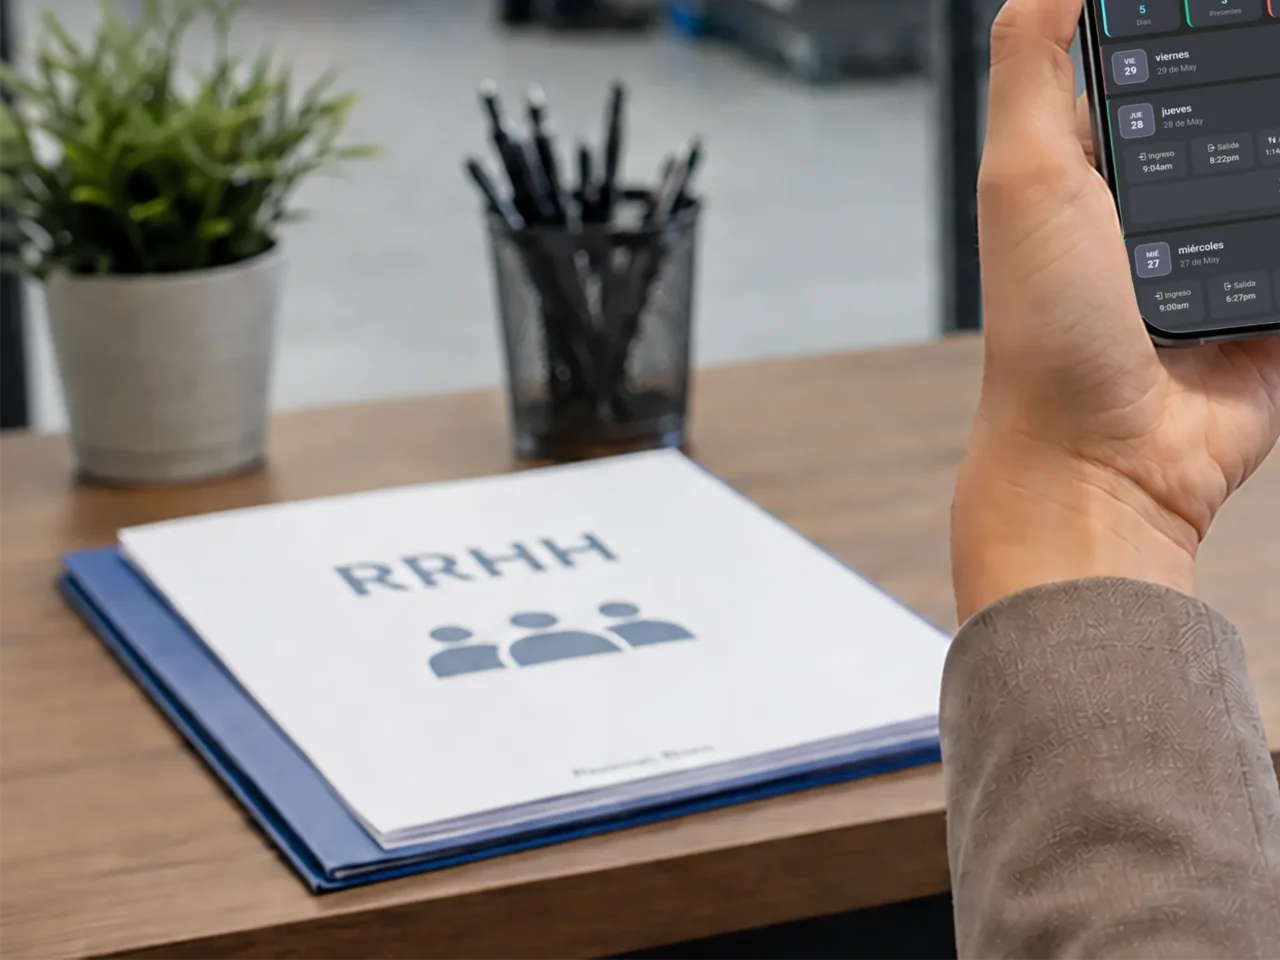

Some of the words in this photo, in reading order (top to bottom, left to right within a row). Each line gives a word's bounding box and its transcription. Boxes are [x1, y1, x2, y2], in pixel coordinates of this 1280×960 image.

[1139, 5, 1146, 14] 5
[1209, 8, 1242, 17] Presentes
[1155, 50, 1190, 62] viernes
[1124, 67, 1137, 76] 29
[1157, 67, 1167, 75] 29
[1169, 66, 1179, 74] de
[1180, 64, 1197, 73] May
[1162, 105, 1192, 118] jueves
[1131, 120, 1144, 130] 28
[1164, 121, 1174, 129] 28
[1175, 119, 1185, 127] de
[1186, 118, 1204, 126] May
[1217, 142, 1240, 151] Salida
[1148, 150, 1175, 161] Ingreso
[1210, 155, 1240, 165] 8:22pm
[1142, 163, 1173, 173] 9:04am
[1178, 241, 1224, 255] miércoles
[1147, 260, 1160, 269] 27
[1180, 260, 1190, 268] 27
[1203, 257, 1220, 265] May
[1234, 281, 1256, 290] Salida
[1164, 290, 1192, 300] Ingreso
[1226, 293, 1256, 303] 6:27pm
[1159, 302, 1189, 312] 9:00am
[334, 532, 618, 596] RRHH
